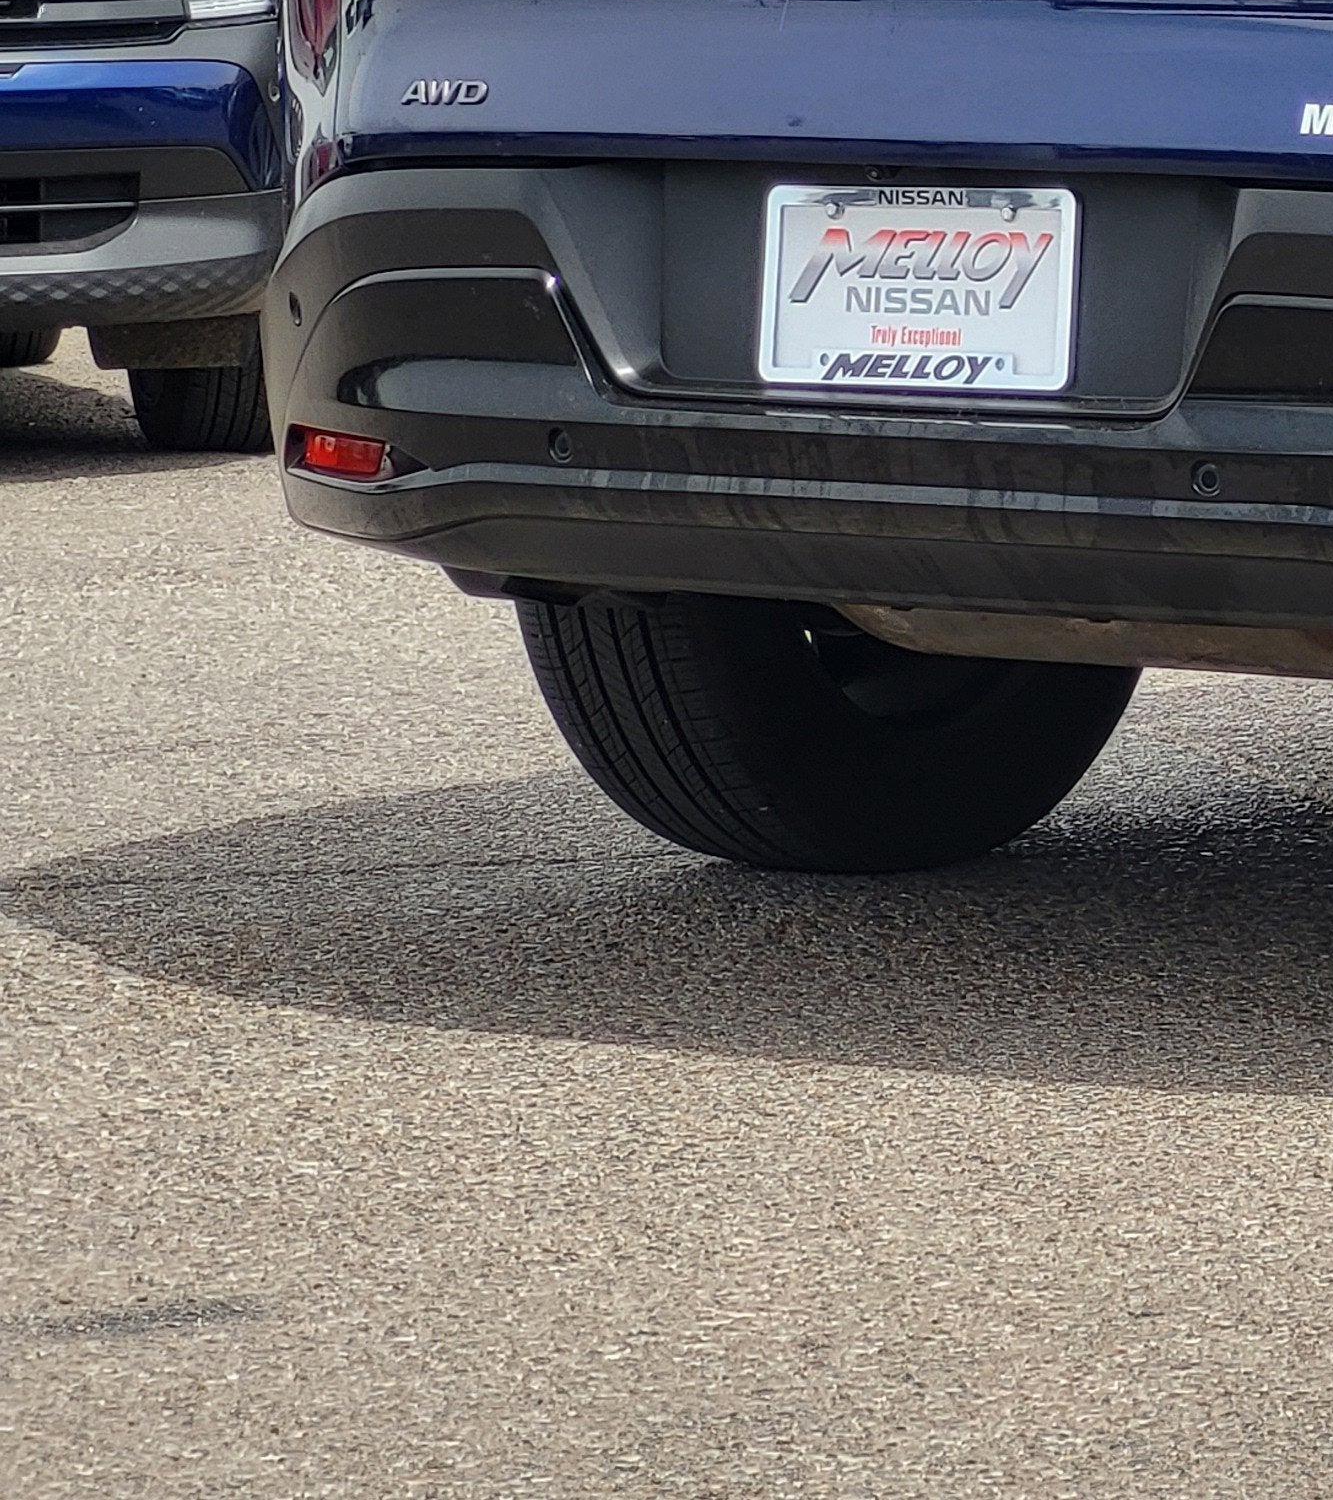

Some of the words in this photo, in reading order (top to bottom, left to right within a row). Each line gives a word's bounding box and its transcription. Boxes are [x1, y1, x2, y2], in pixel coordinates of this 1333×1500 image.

[401, 79, 489, 105] AWD
[878, 190, 964, 206] NISSAN
[789, 228, 1054, 310] MELLOY
[846, 286, 991, 316] NISSAN
[871, 325, 897, 346] Truly
[901, 326, 962, 348] Exceptional
[822, 353, 993, 384] MELLOY
